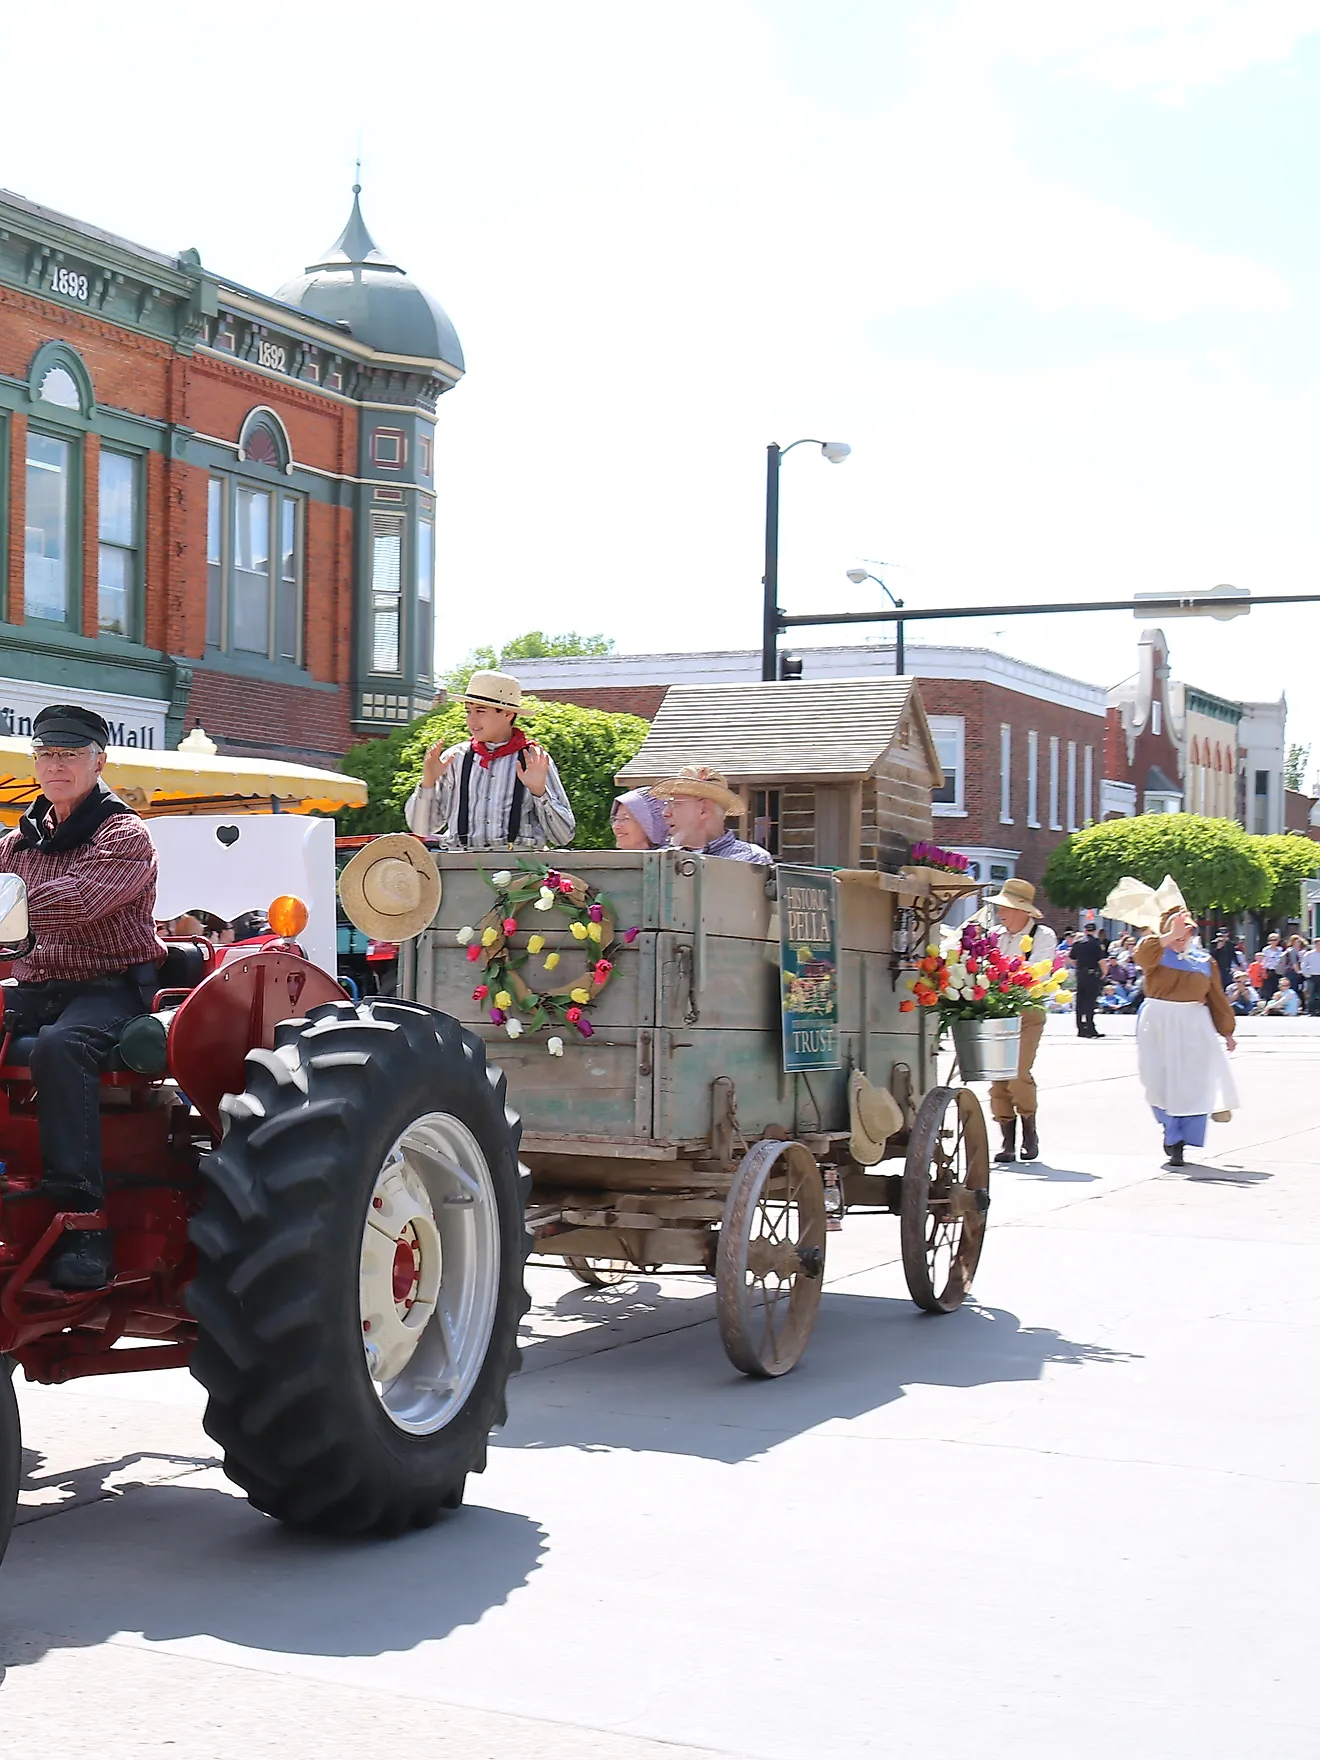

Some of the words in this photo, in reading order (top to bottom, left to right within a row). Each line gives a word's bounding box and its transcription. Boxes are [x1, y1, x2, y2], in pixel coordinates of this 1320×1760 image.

[50, 265, 90, 301] 1893
[257, 339, 287, 373] 1892
[107, 721, 155, 750] Mall
[786, 886, 829, 911] HISTORIC
[787, 911, 832, 941] PELLA
[792, 1029, 834, 1054] TRUST
